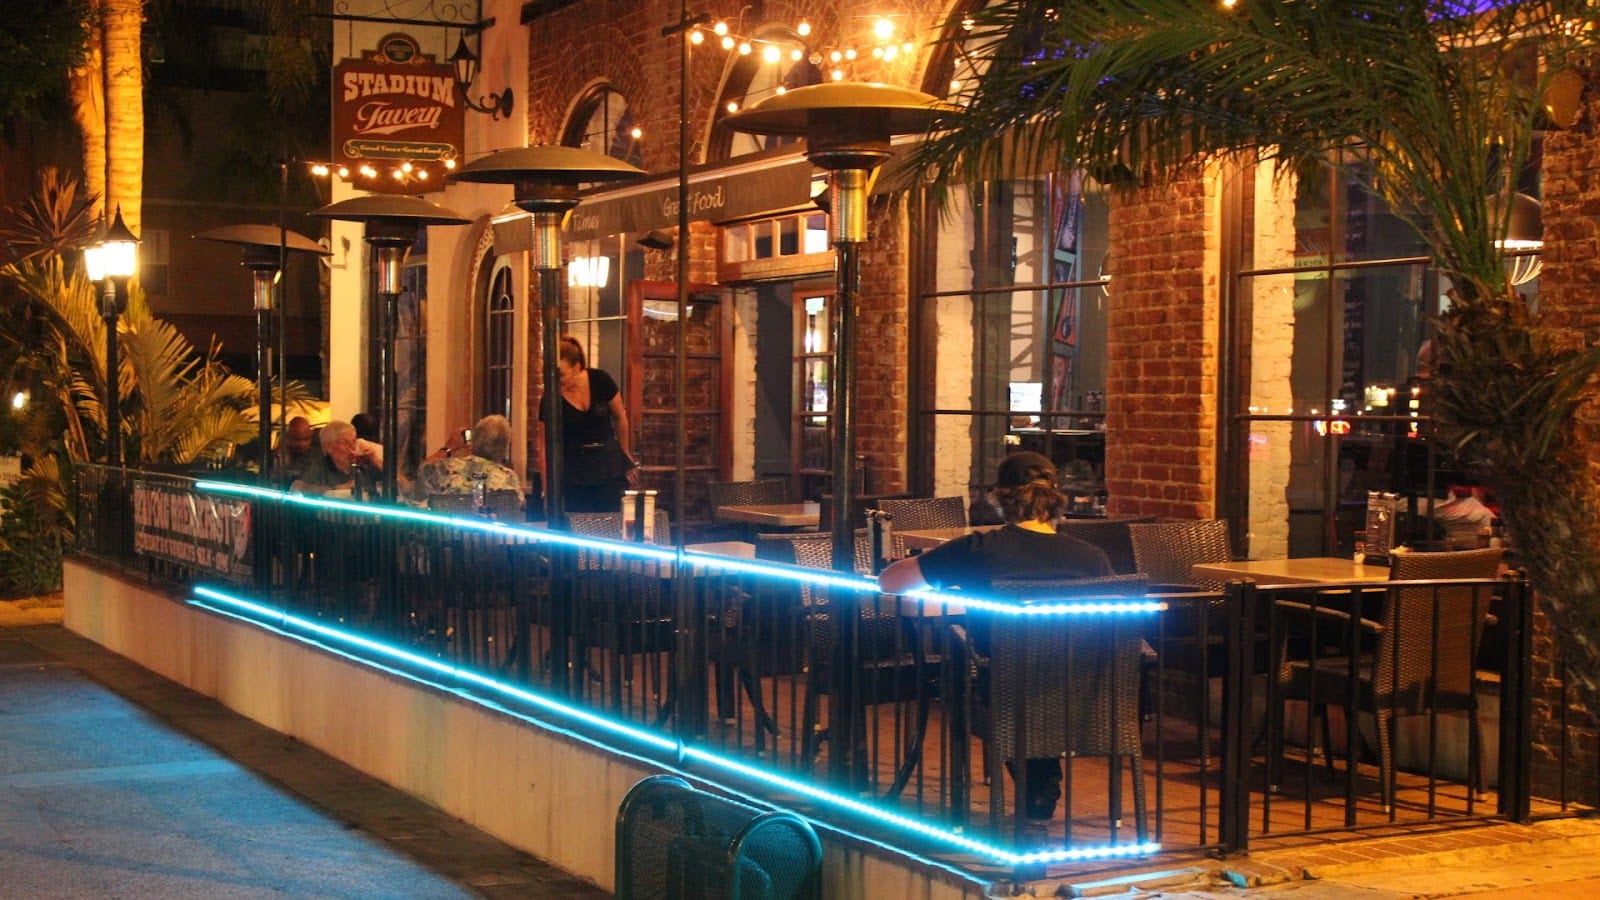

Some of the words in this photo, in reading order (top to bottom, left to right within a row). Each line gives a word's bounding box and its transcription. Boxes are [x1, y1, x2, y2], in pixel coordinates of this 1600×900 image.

[343, 71, 455, 108] STADIUM
[353, 101, 442, 135] Tavern
[692, 185, 726, 215] Food
